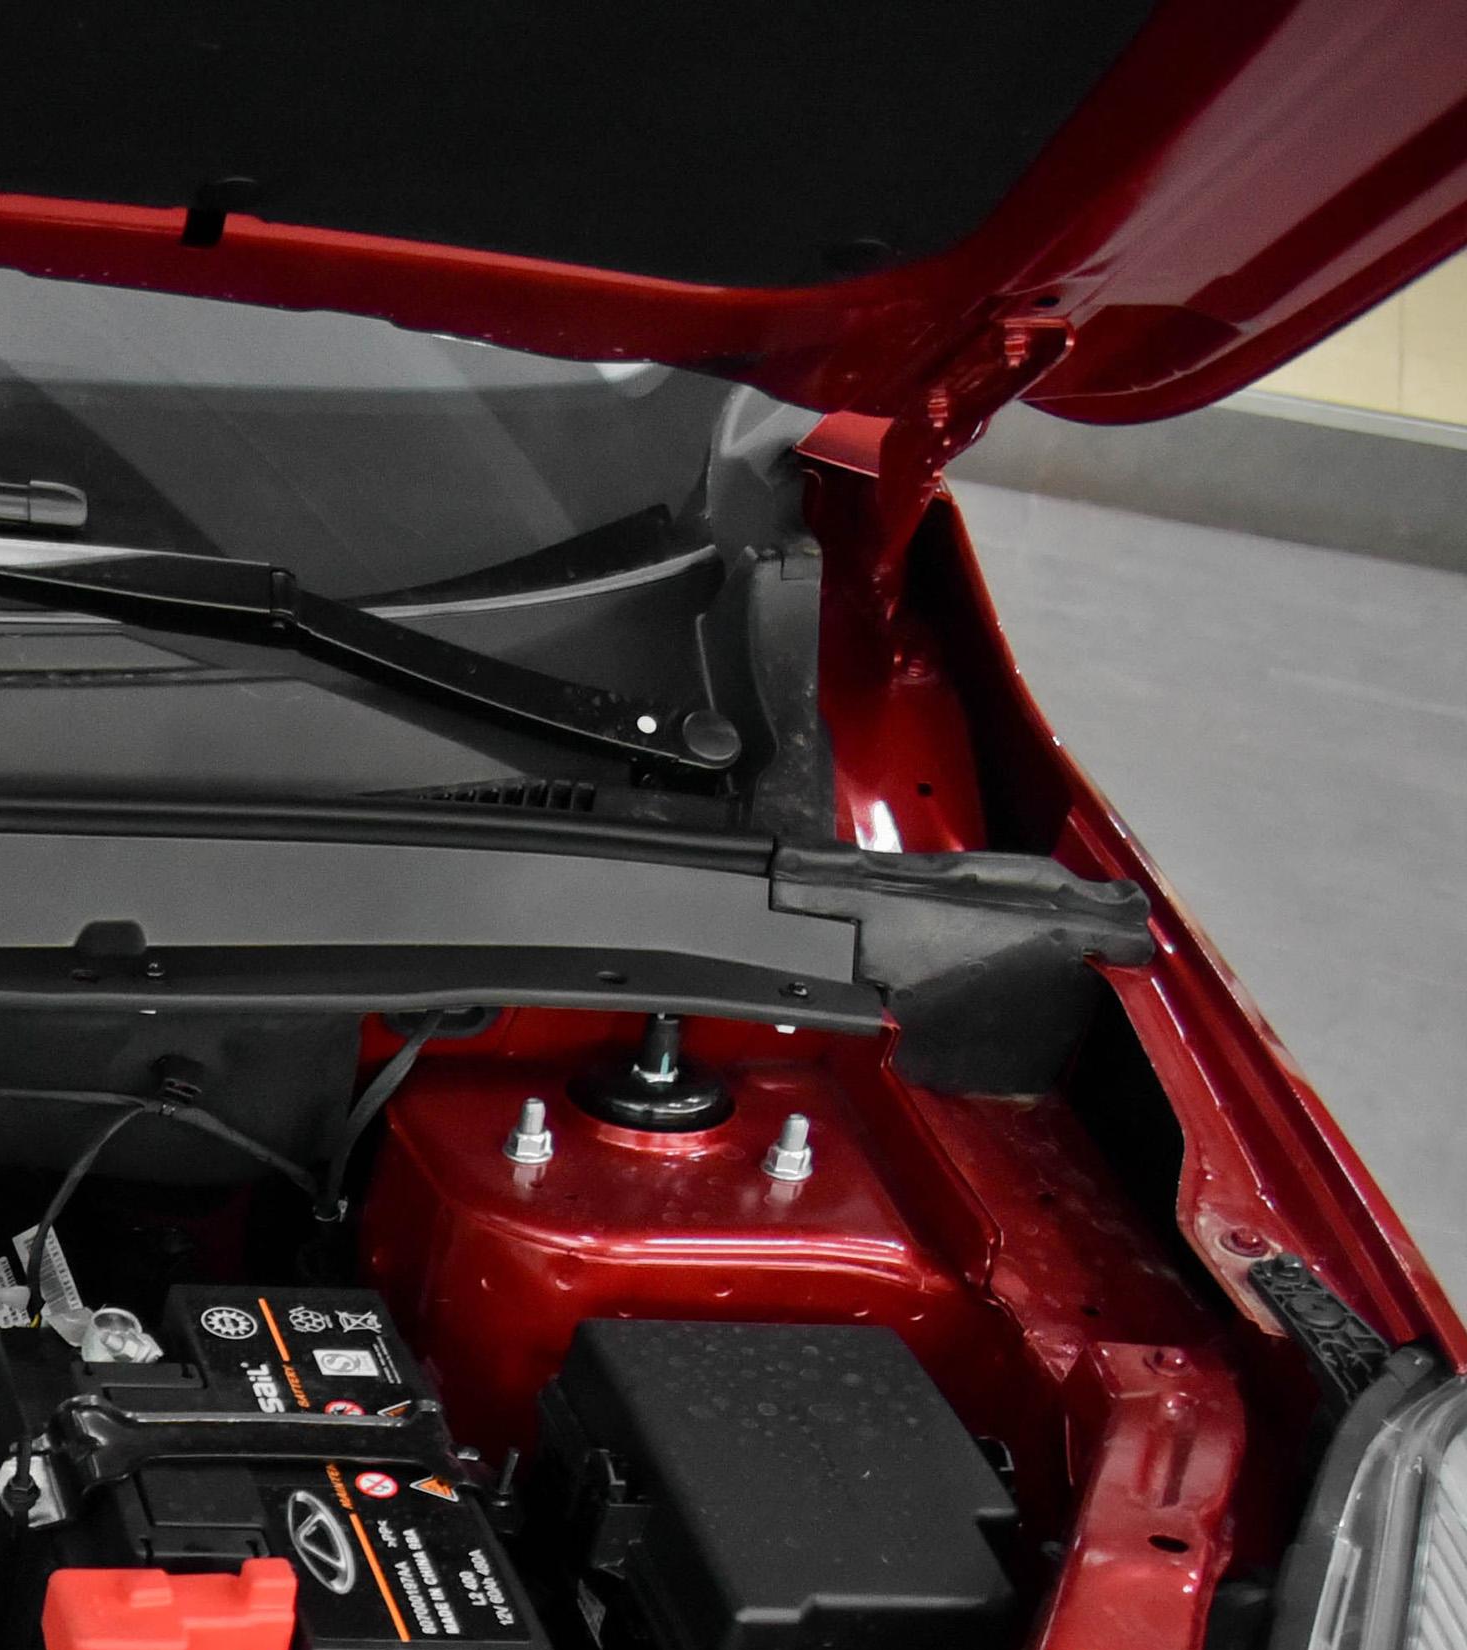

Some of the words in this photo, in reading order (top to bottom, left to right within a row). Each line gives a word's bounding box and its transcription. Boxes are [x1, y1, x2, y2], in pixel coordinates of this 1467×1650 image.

[412, 1551, 439, 1586] CHINA
[428, 1587, 446, 1601] IN
[434, 1602, 460, 1634] MADE
[492, 1605, 515, 1625] 12V
